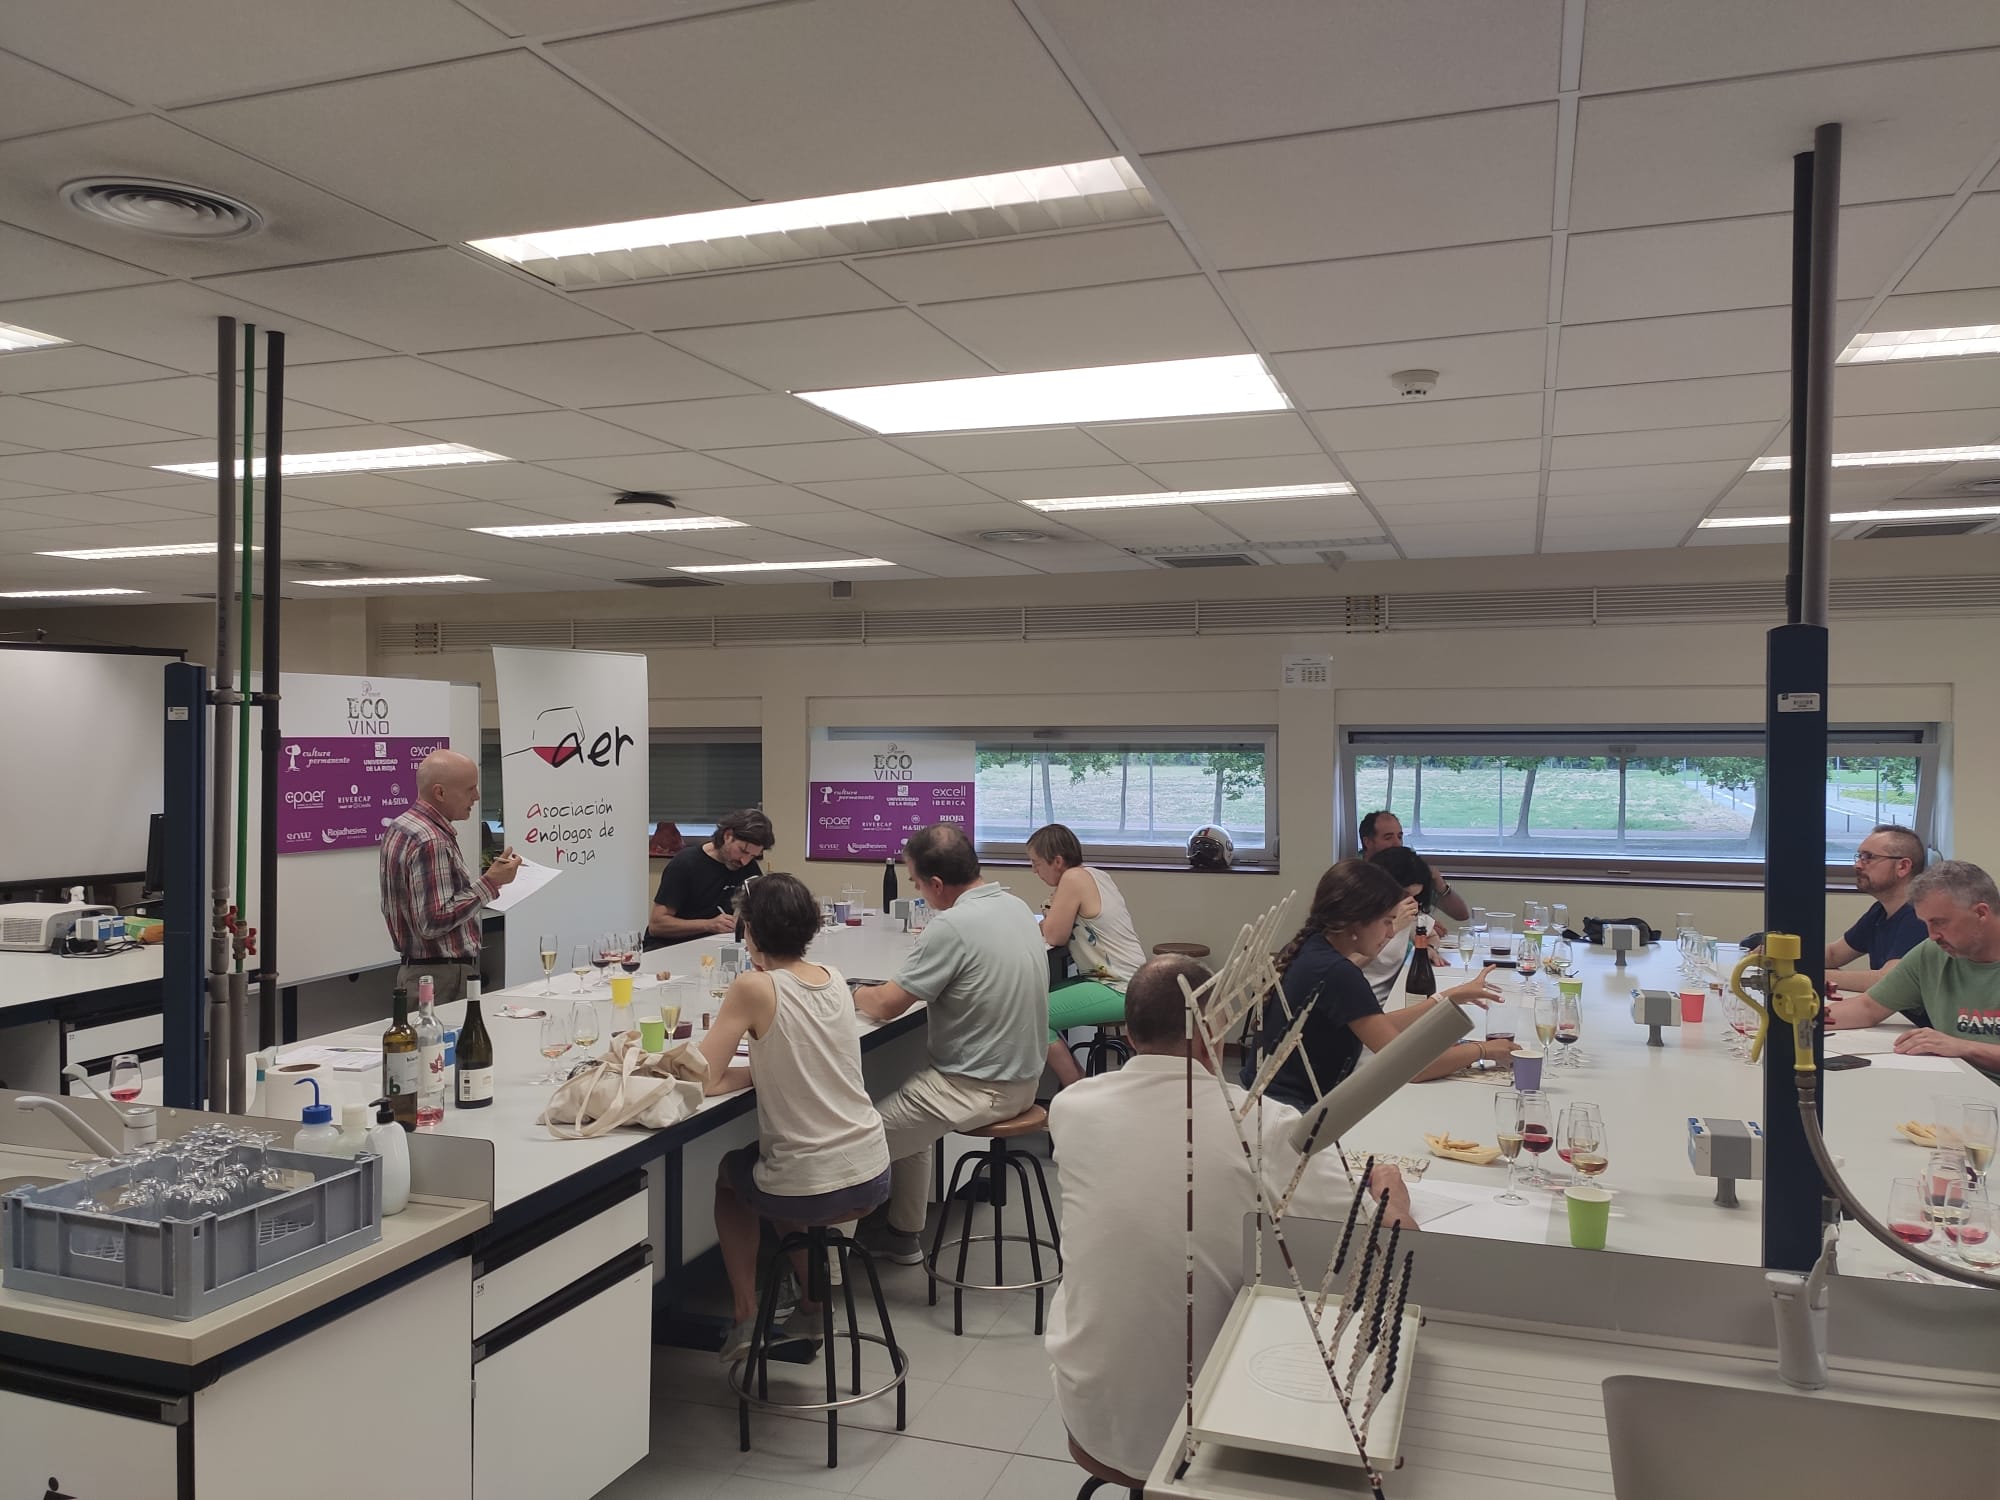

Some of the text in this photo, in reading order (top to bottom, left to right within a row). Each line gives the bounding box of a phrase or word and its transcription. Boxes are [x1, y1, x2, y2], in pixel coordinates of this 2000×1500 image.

[346, 697, 389, 719] ECO
[347, 720, 390, 735] VINO
[302, 747, 331, 757] cultura
[552, 726, 634, 768] aer
[305, 757, 351, 768] permanente
[873, 754, 913, 770] ECO
[874, 770, 913, 780] VINO
[932, 785, 966, 797] excell
[337, 796, 372, 804] RIVERCAP
[526, 798, 613, 818] asociación
[525, 821, 615, 843] enólogos de
[555, 846, 596, 865] rioja
